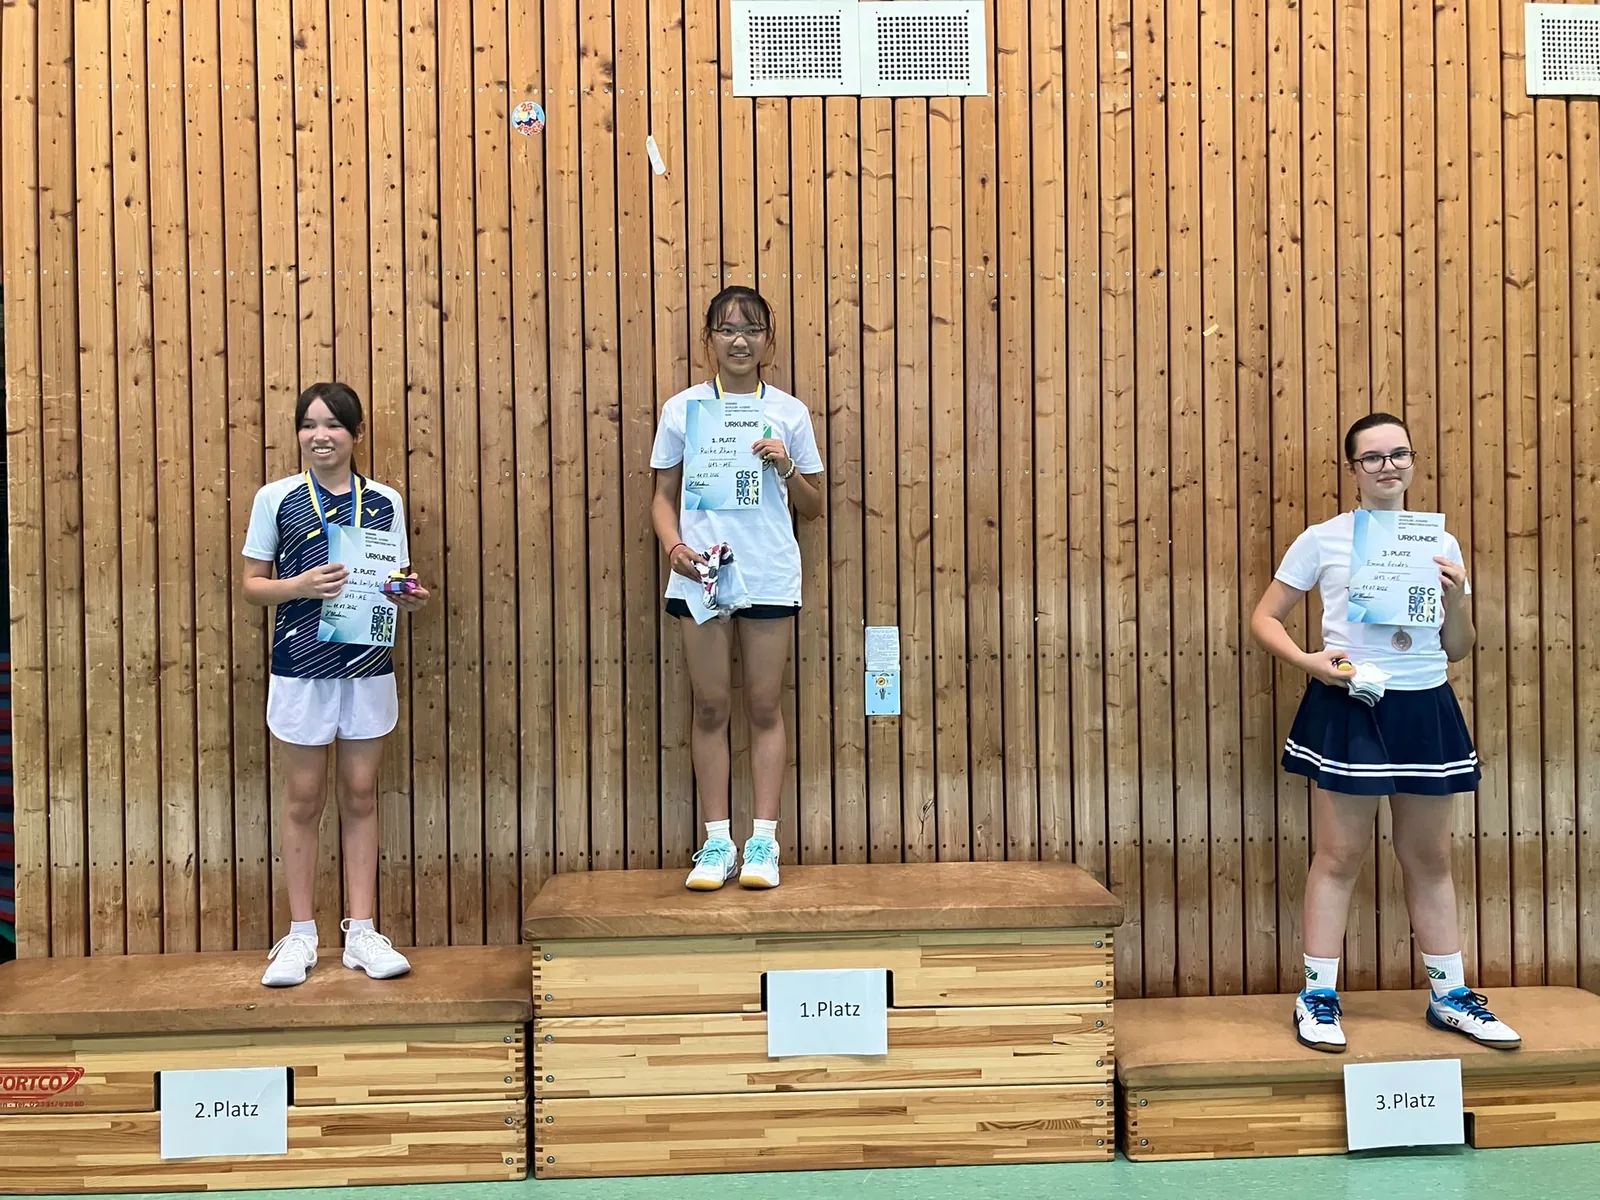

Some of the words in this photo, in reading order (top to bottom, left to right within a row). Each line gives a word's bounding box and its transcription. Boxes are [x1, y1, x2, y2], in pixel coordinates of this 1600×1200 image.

[736, 497, 759, 505] TON
[1398, 534, 1438, 543] URKUNDE
[365, 552, 396, 563] URKUNDE
[1408, 613, 1435, 623] TON
[370, 632, 391, 642] TON
[800, 1000, 861, 1018] 1.Platz
[1376, 1092, 1436, 1110] 3.Platz
[195, 1100, 259, 1118] 2.Platz
